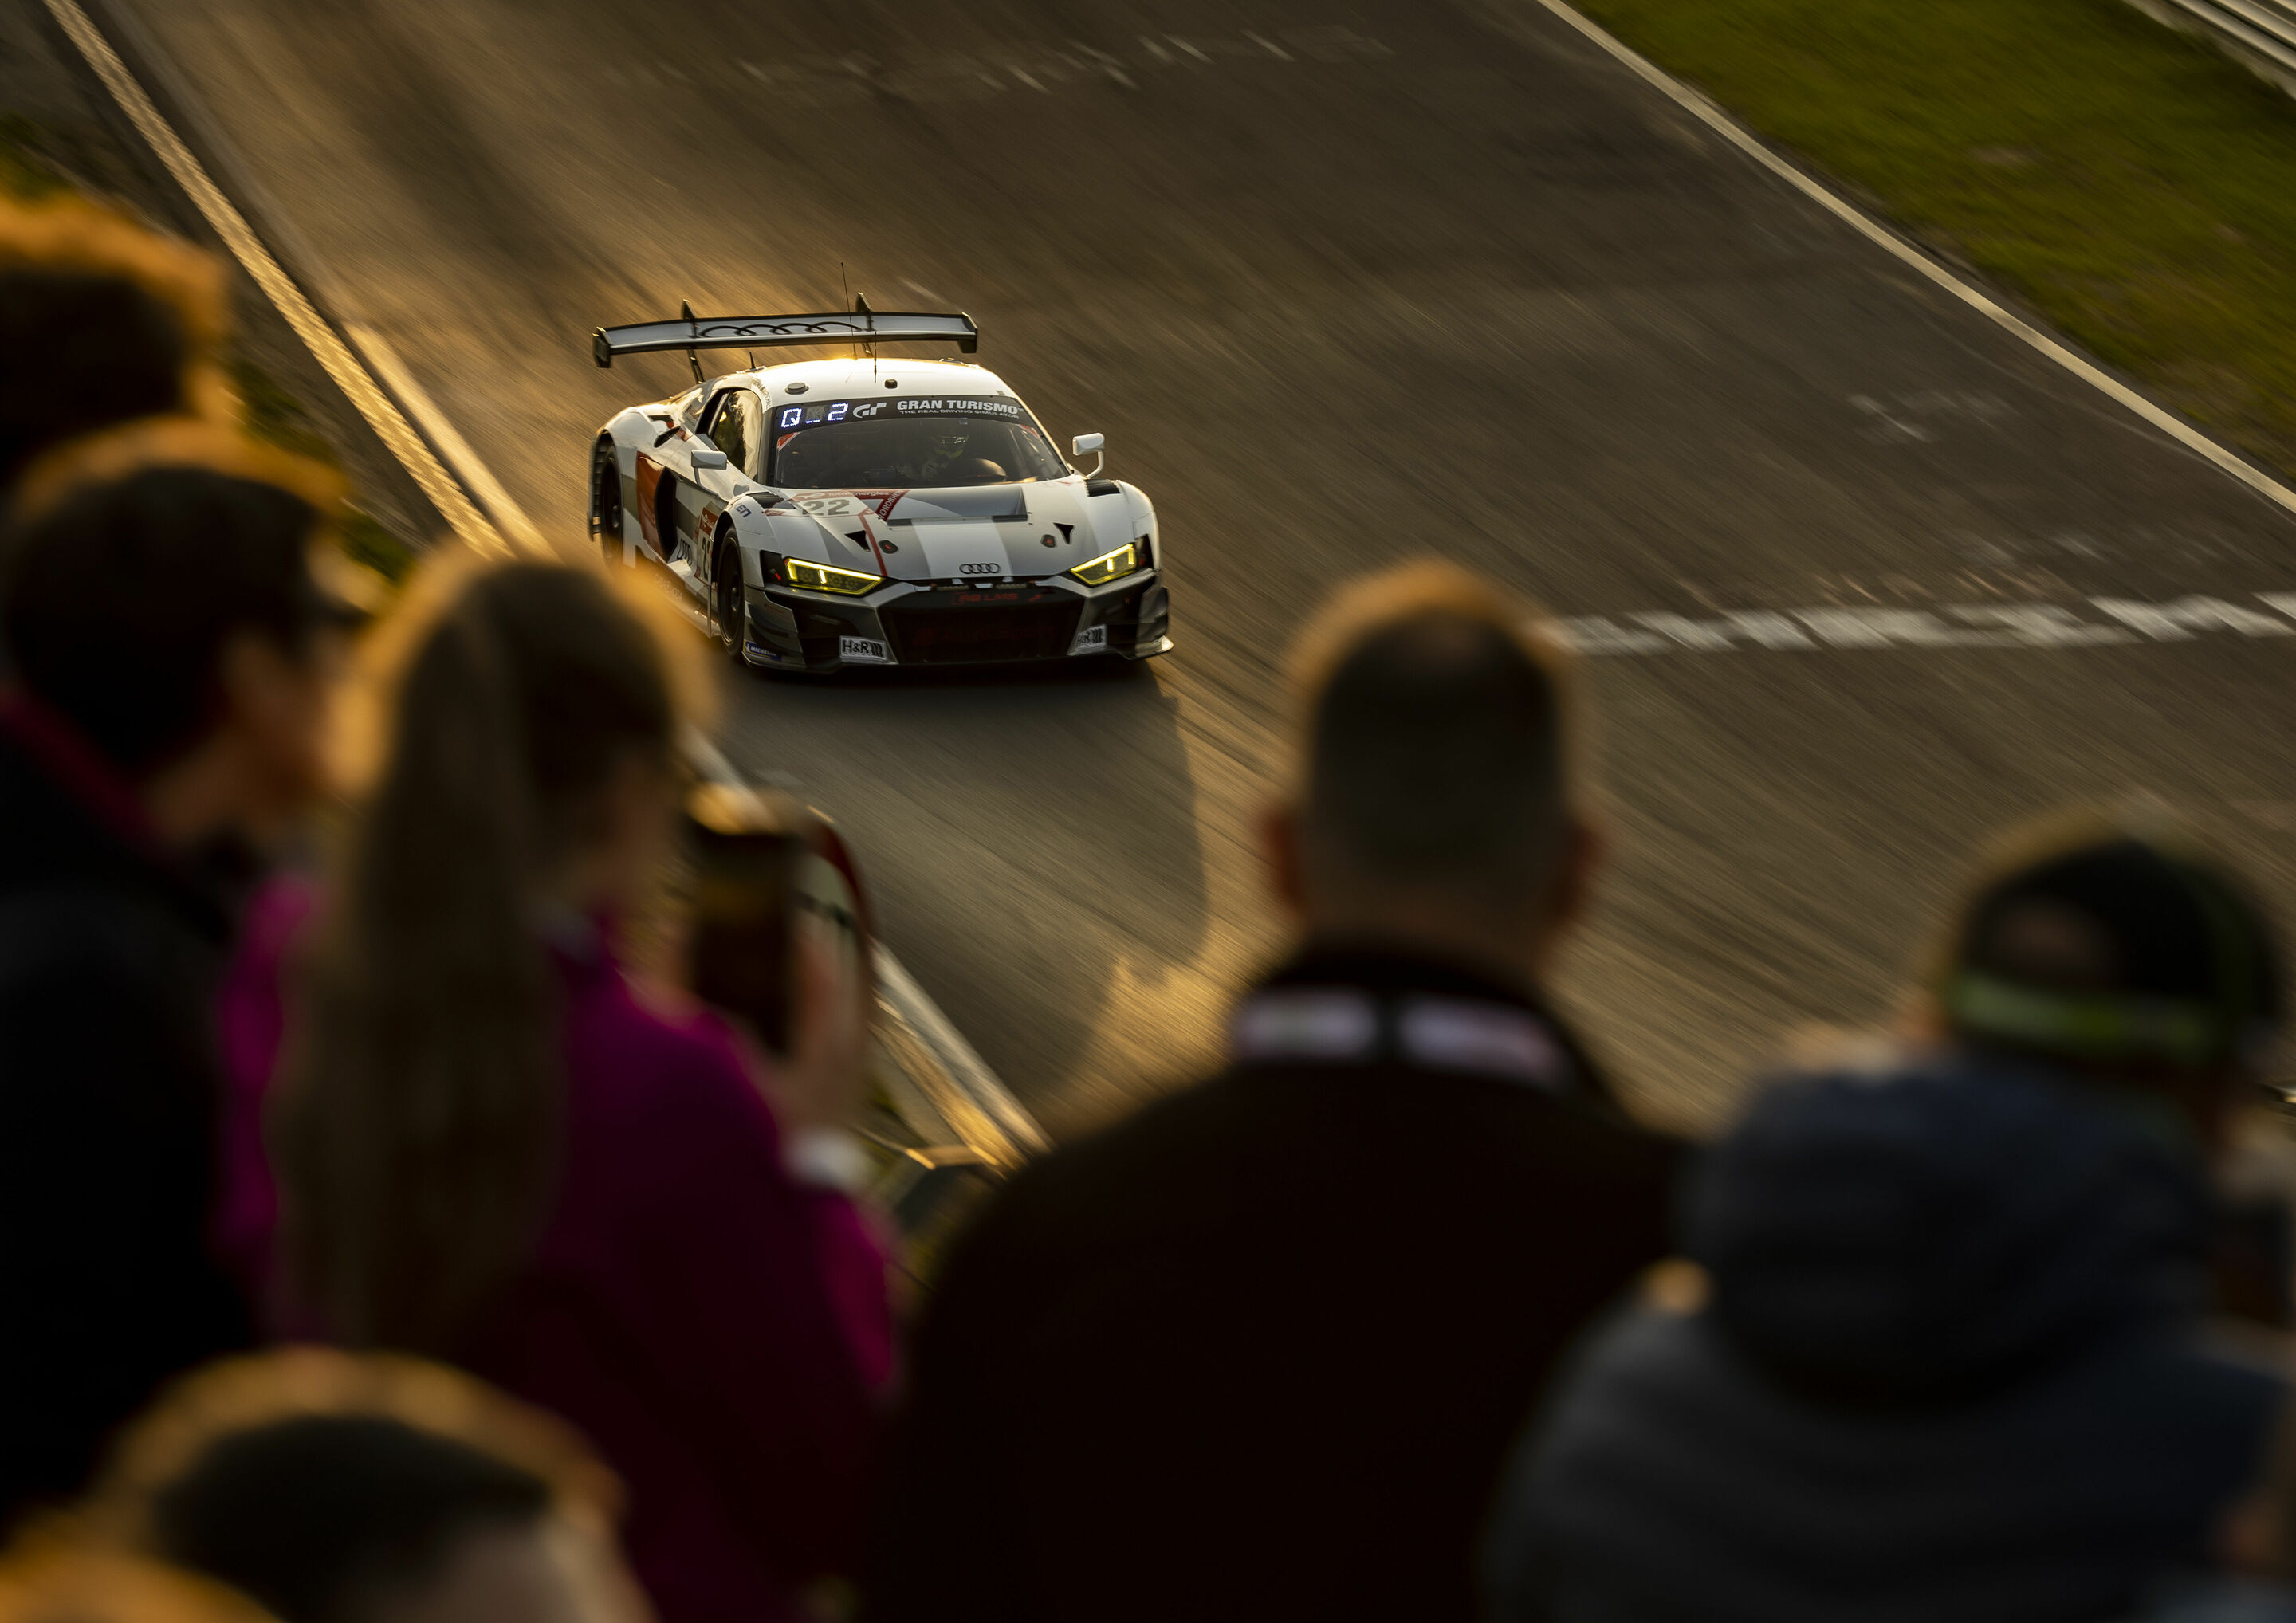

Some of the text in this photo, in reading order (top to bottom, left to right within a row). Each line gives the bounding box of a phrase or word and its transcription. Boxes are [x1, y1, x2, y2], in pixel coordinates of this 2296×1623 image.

[897, 400, 1018, 414] GRAN TURISMO
[974, 410, 1020, 419] SIMULATOR
[802, 499, 849, 516] 22
